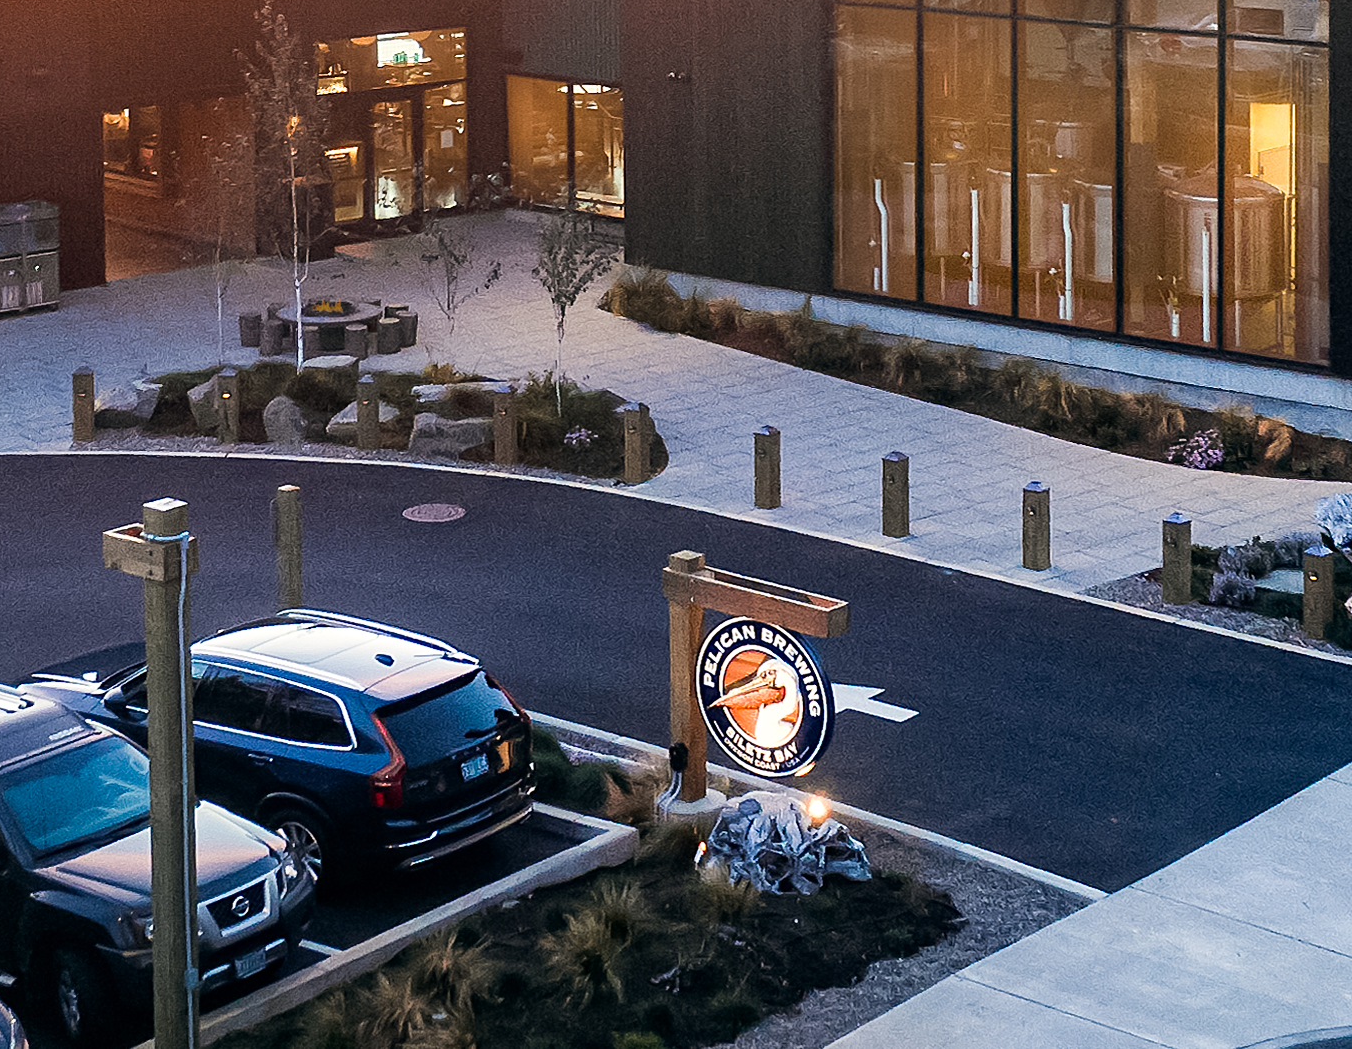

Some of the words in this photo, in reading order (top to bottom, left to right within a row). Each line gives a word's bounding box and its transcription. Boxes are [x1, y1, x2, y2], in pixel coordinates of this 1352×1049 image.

[703, 625, 755, 688] PELICAN
[761, 627, 821, 718] BREWING
[774, 741, 798, 763] BAY
